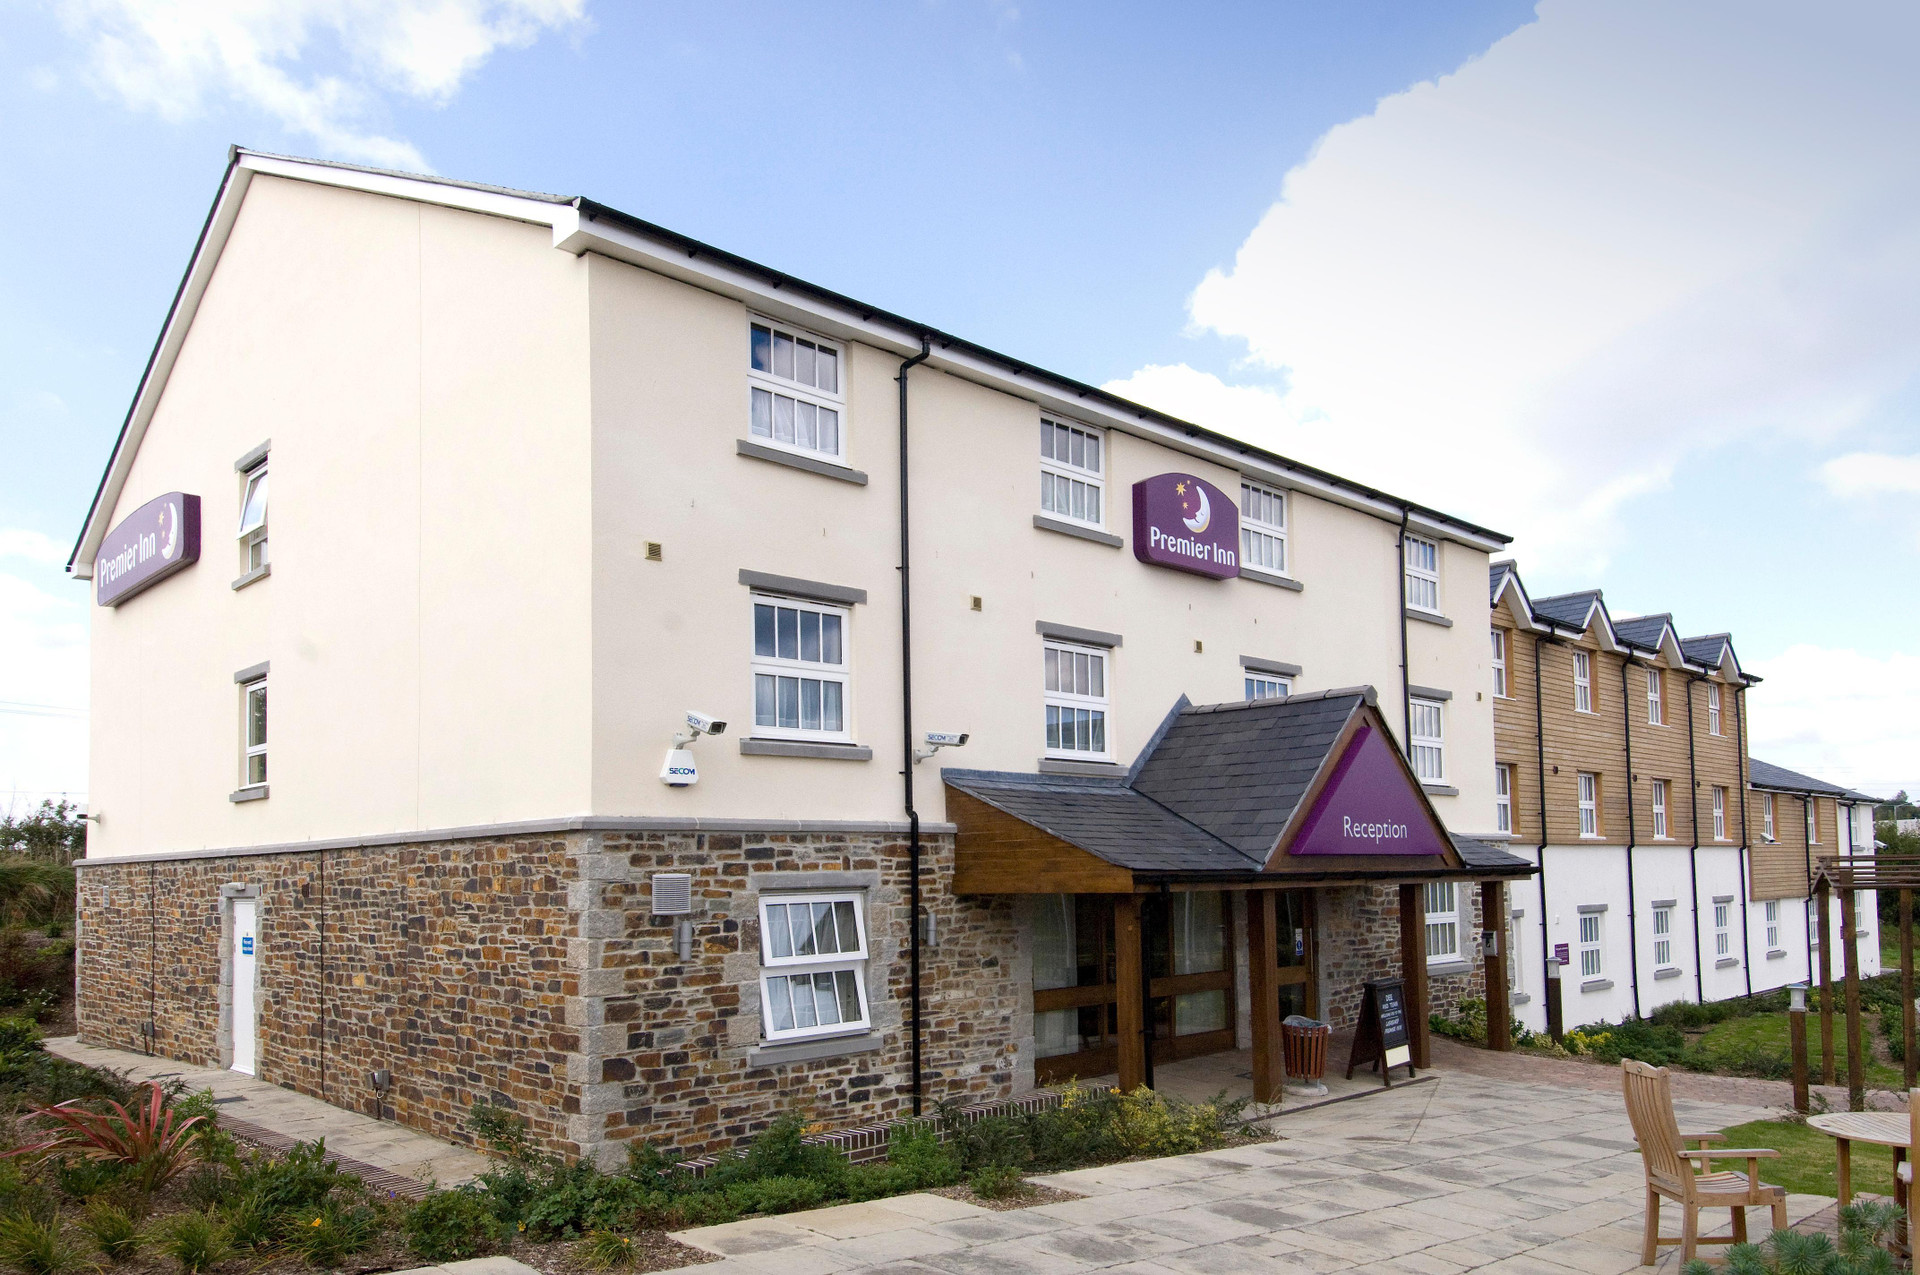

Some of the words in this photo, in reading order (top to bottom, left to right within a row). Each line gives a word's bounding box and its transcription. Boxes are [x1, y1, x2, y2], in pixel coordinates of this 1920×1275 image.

[1150, 526, 1211, 560] Premier
[1213, 542, 1235, 567] Inn
[100, 543, 138, 588] Premier
[139, 532, 156, 564] Inn
[687, 715, 701, 726] SECOM
[928, 733, 946, 741] SECOM
[669, 767, 696, 775] SECOM
[1343, 815, 1408, 845] Reception
